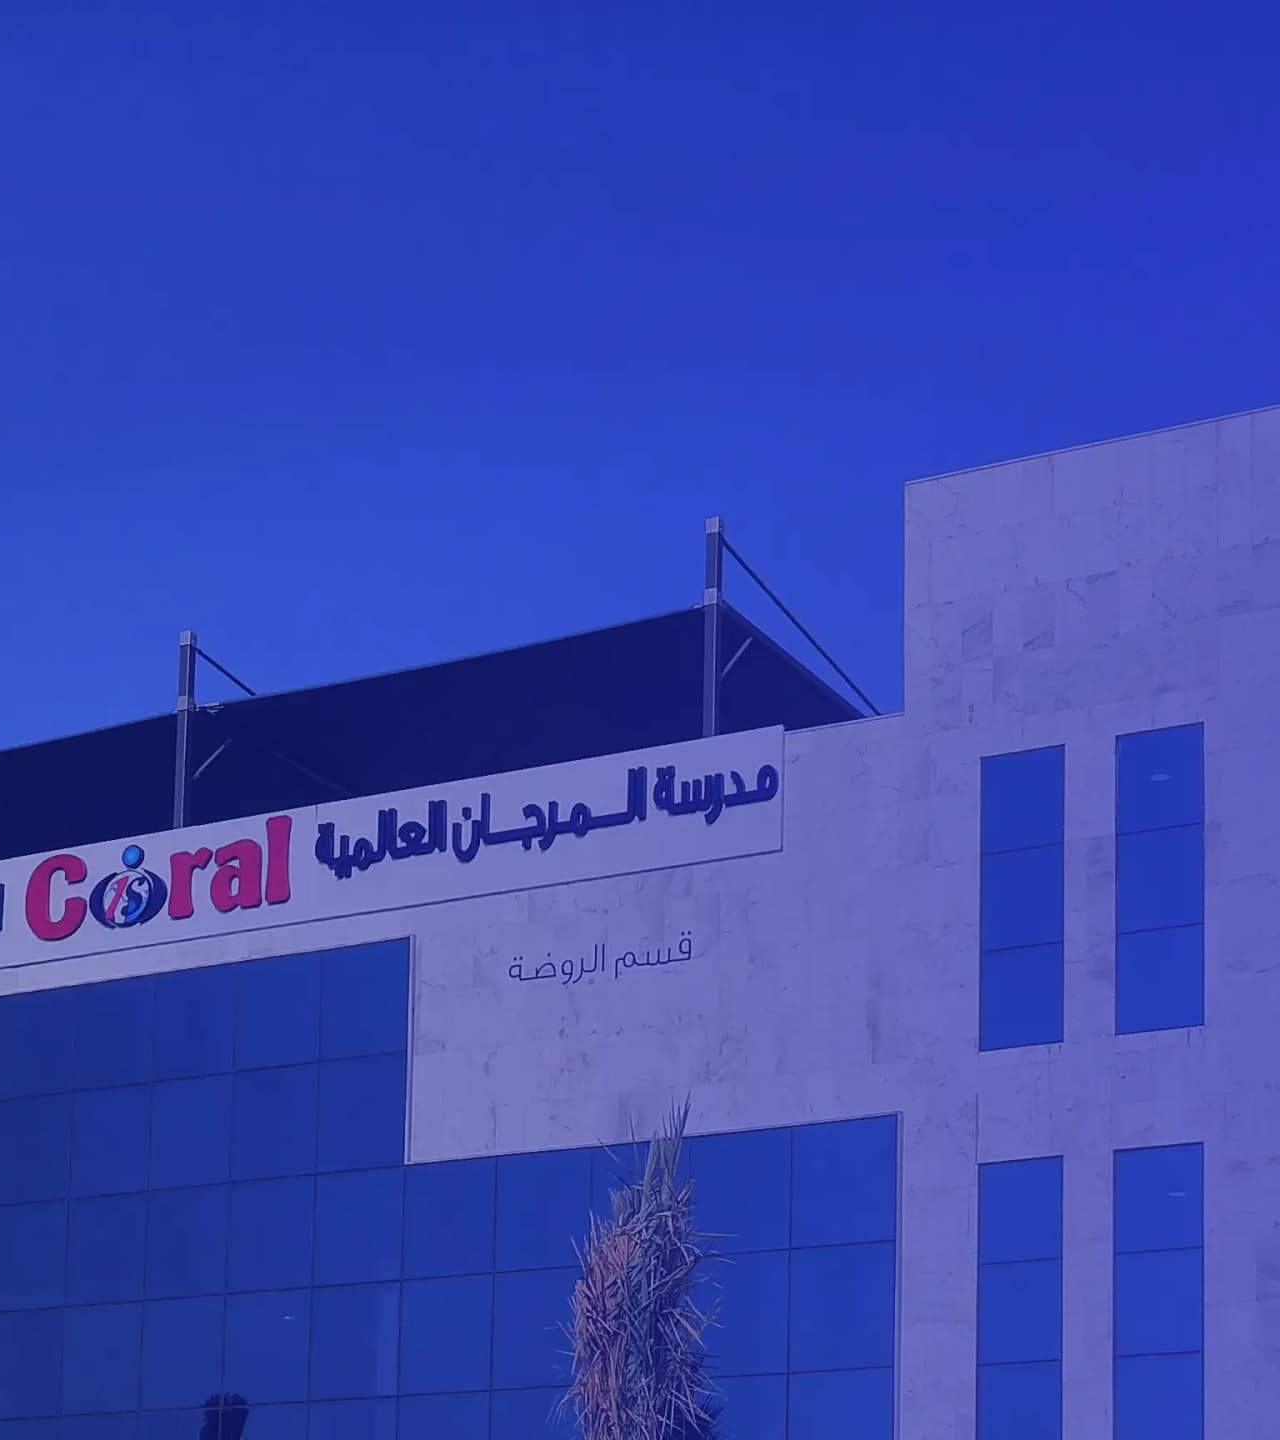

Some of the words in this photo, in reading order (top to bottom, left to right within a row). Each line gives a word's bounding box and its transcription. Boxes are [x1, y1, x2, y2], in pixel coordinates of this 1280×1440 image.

[653, 764, 779, 826] مدرسة
[315, 799, 447, 880] العالمية
[25, 815, 292, 941] Coral
[508, 943, 605, 985] الروضة
[615, 930, 692, 980] قسم
